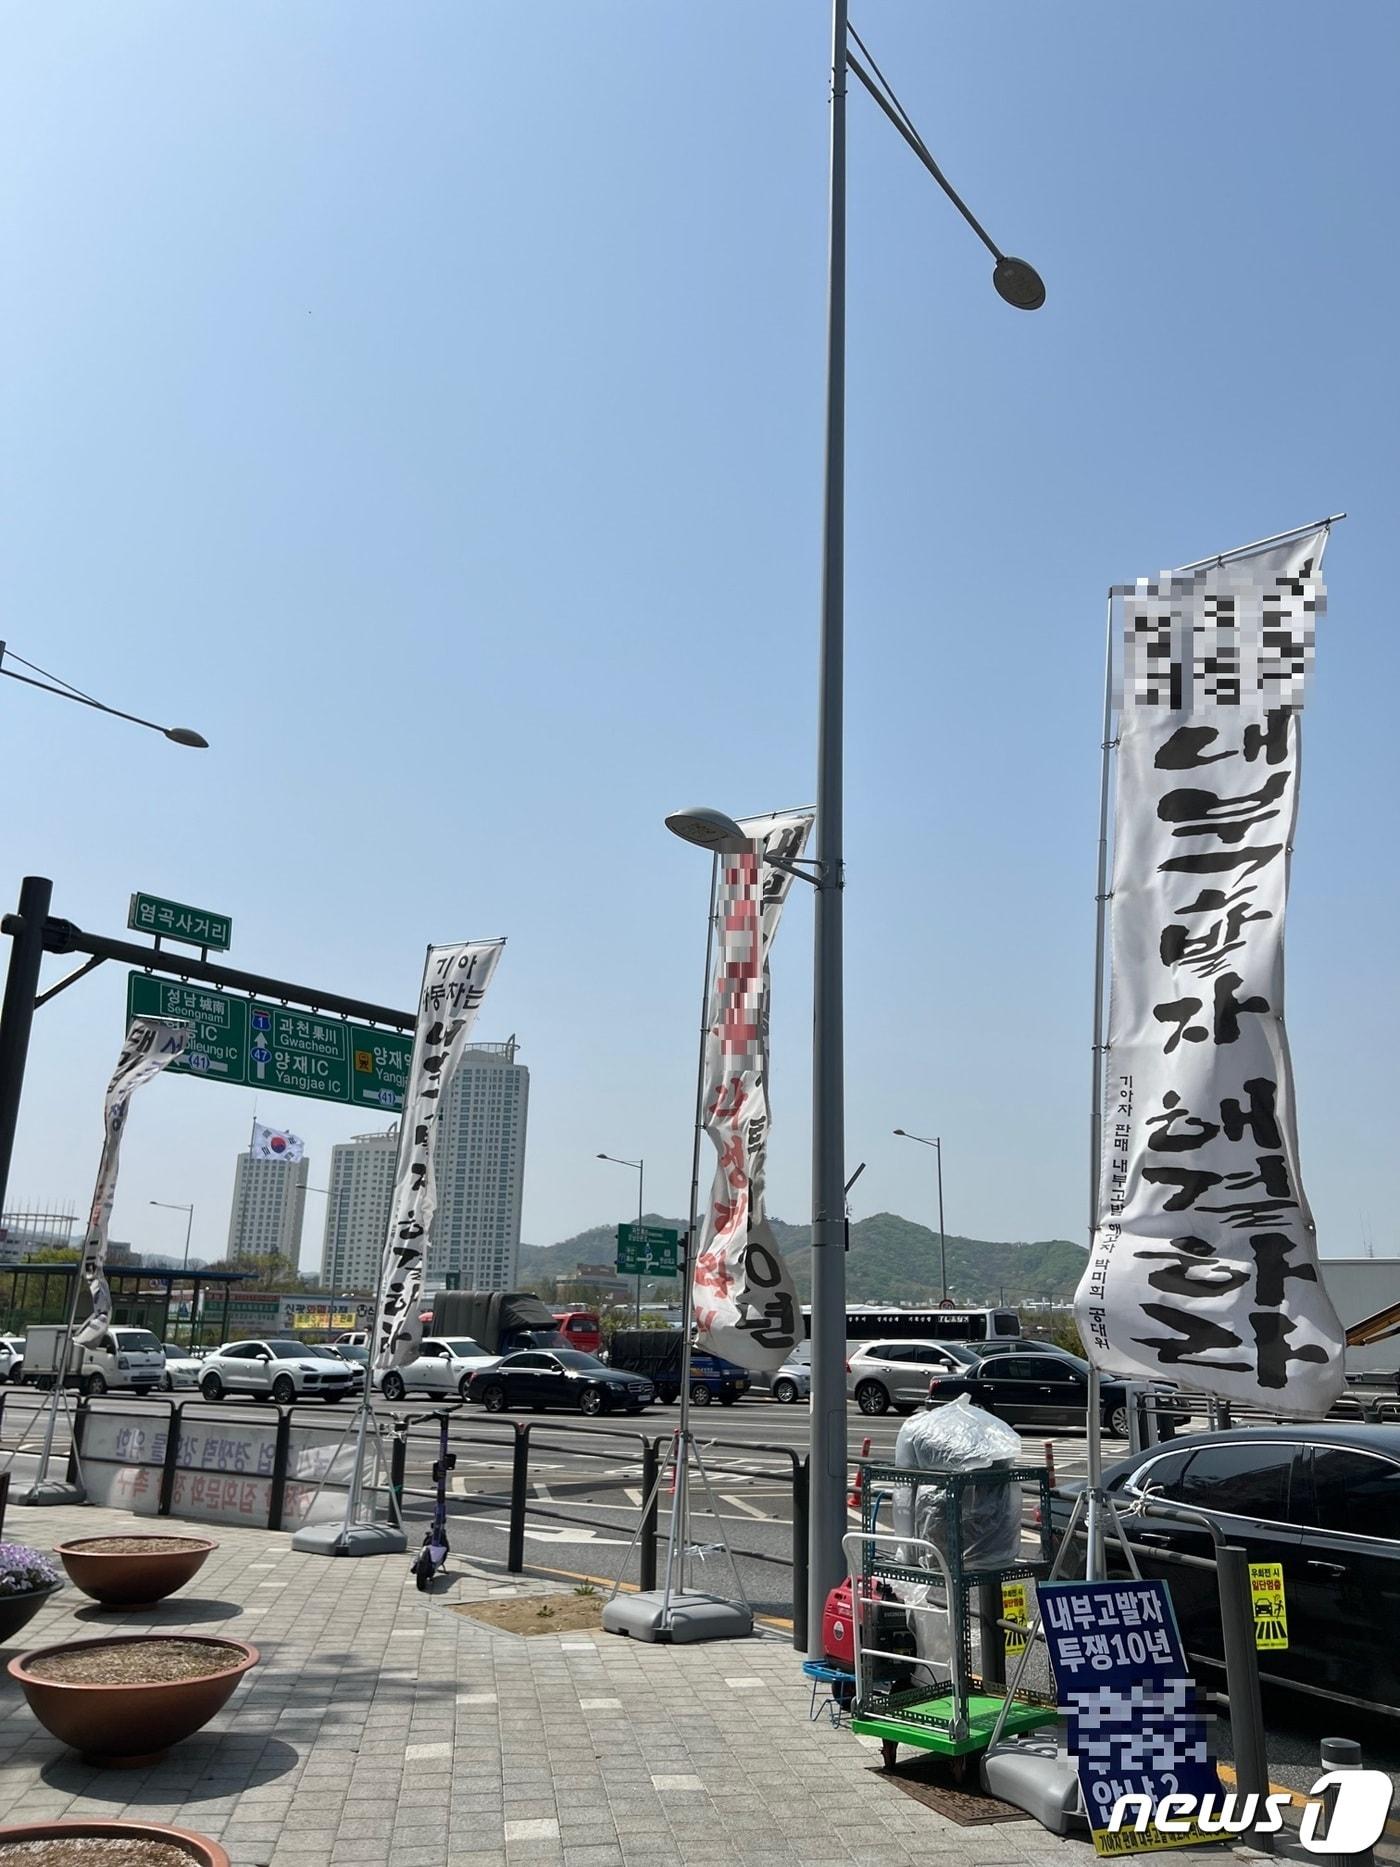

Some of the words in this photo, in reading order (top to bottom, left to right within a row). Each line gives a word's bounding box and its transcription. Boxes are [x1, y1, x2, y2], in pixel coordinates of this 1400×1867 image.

[1153, 708, 1292, 1055] 내부고발자
[140, 903, 227, 942] 염곡사거리
[437, 955, 477, 980] 기아
[167, 1003, 224, 1024] Seongnam
[254, 1050, 267, 1061] 47
[280, 1033, 339, 1056] Gwacheon
[192, 1054, 206, 1069] 41
[275, 1070, 326, 1091] Yangjae
[329, 1079, 341, 1093] IC
[1114, 1124, 1131, 1152] 판매
[1110, 1159, 1128, 1217] 내부고발
[1130, 1077, 1329, 1388] 해결하라
[1089, 1259, 1111, 1300] 박미희
[1046, 1589, 1164, 1631] 내부고발자
[1057, 1628, 1174, 1673] 투쟁10년
